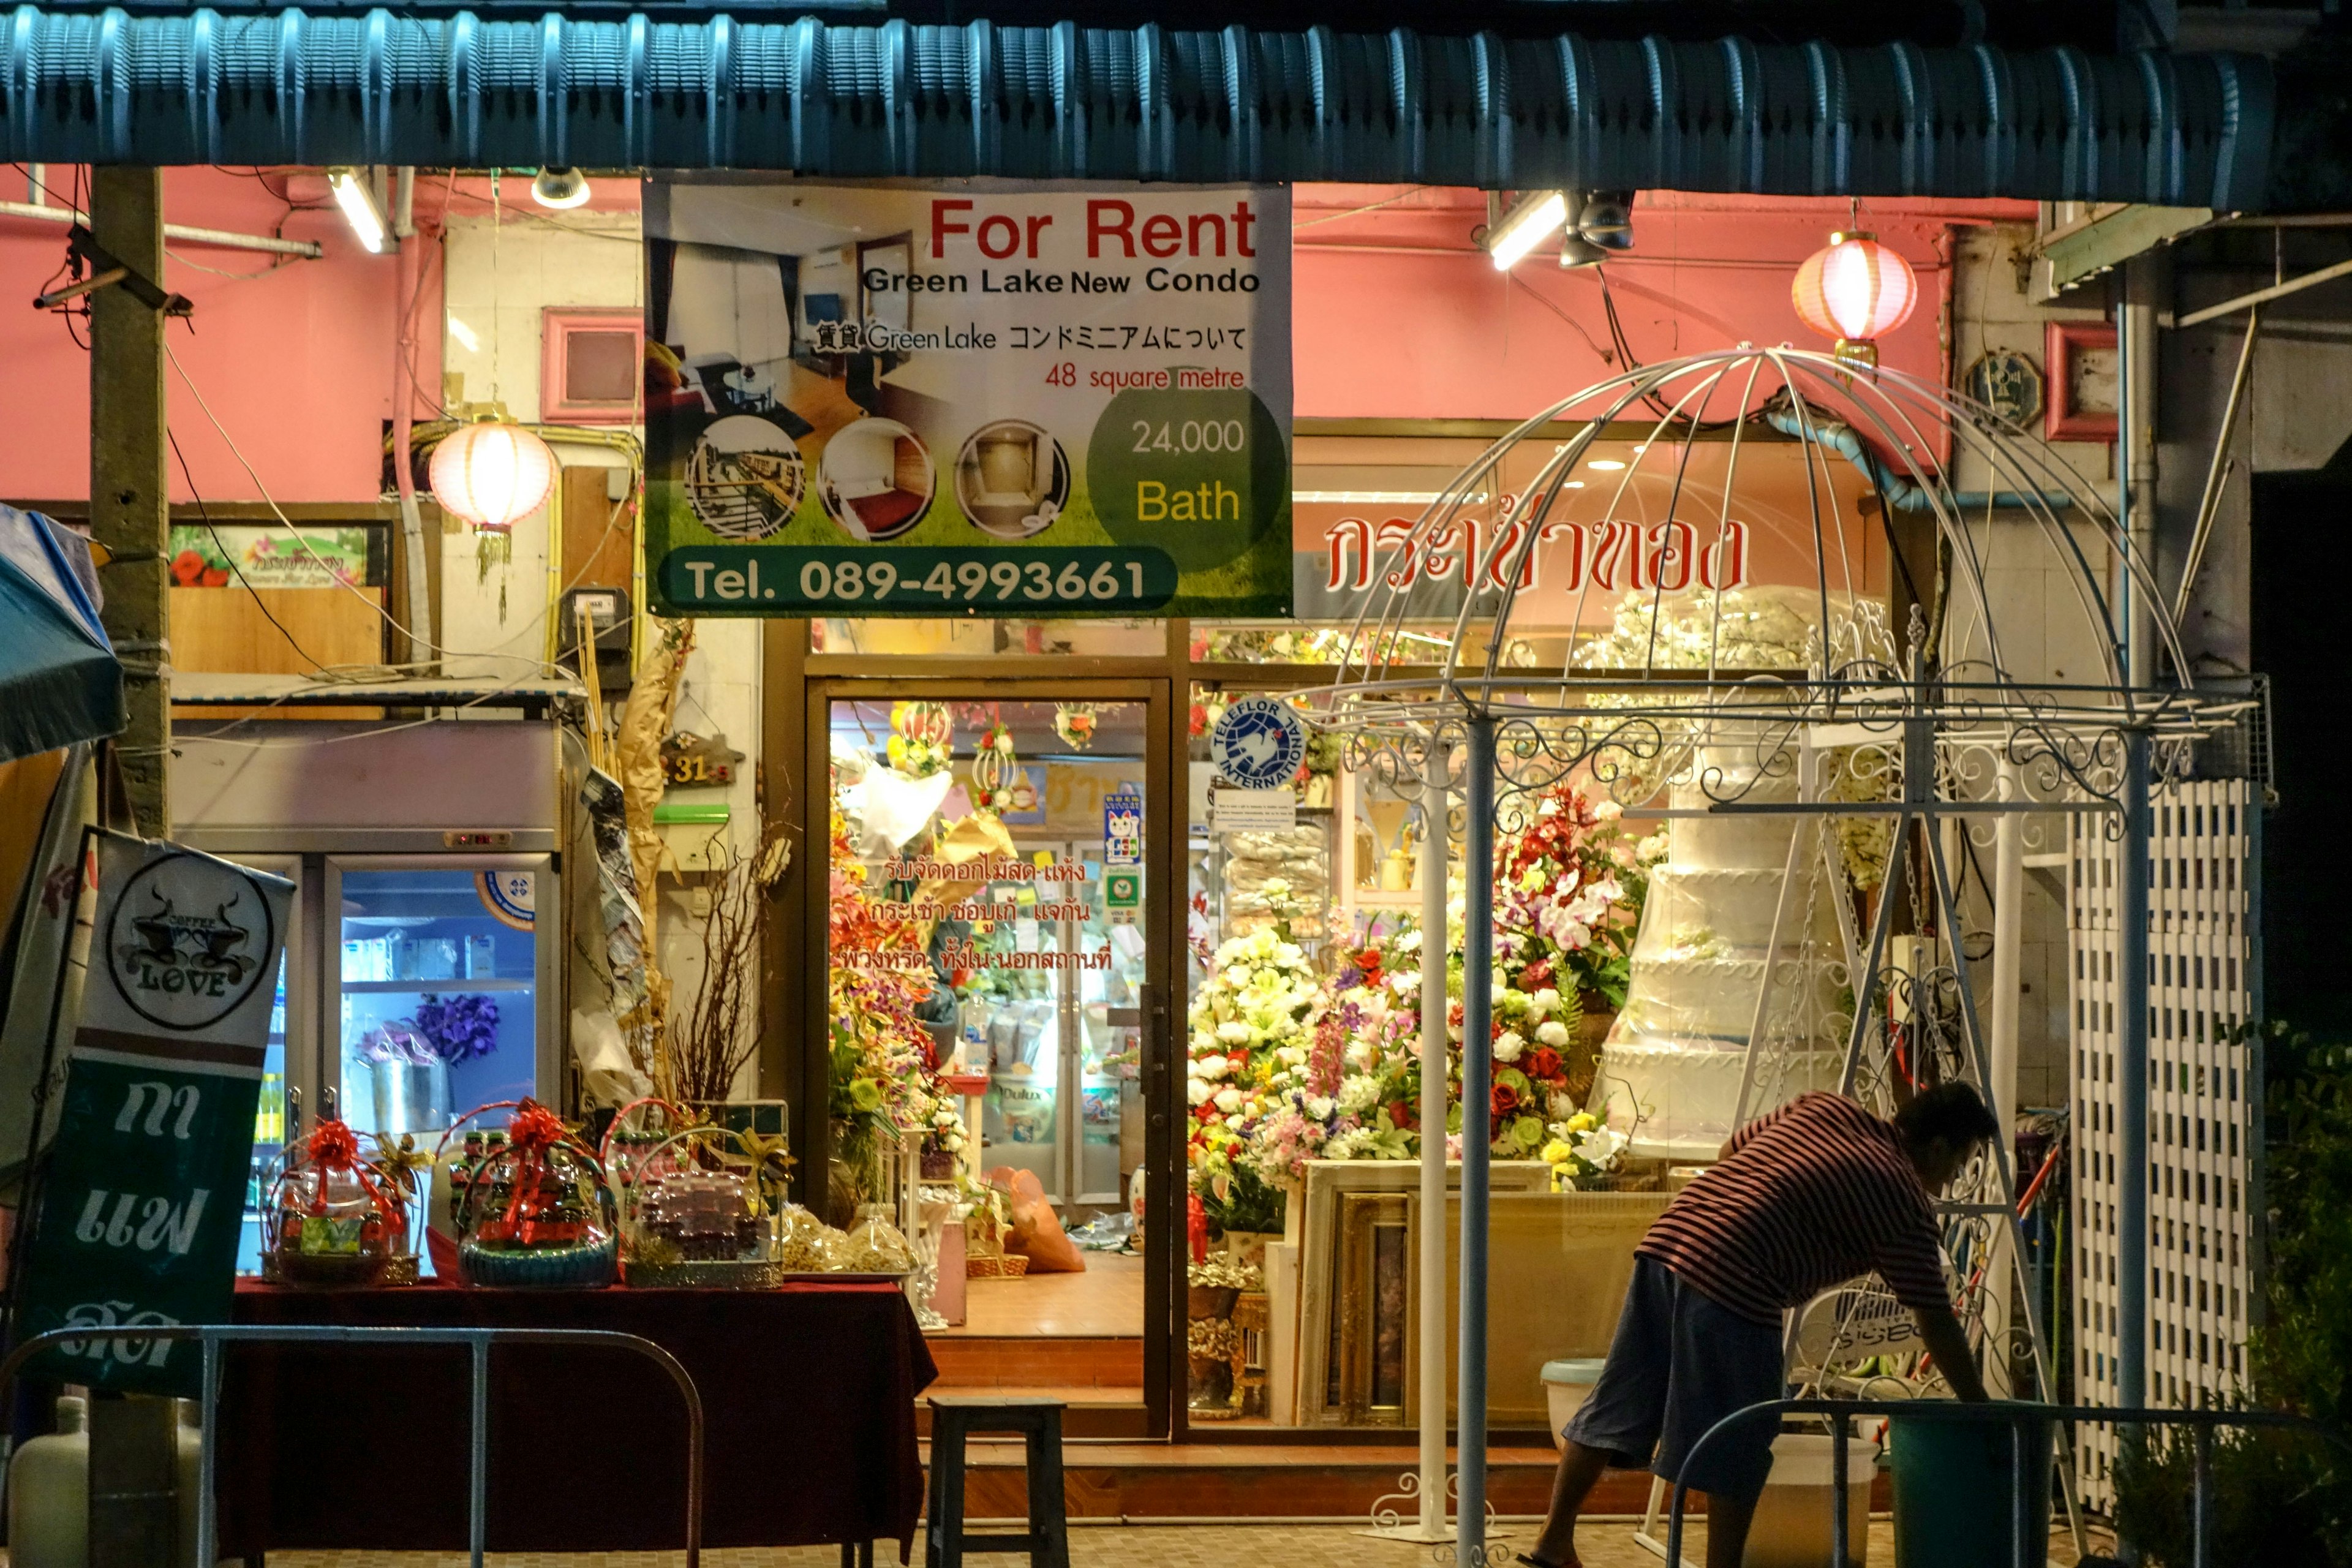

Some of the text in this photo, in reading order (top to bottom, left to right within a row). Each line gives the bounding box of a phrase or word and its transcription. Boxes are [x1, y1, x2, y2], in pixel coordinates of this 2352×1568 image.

[930, 199, 1256, 258] For Rent
[864, 266, 1260, 294] Green Lake New Condo
[869, 325, 939, 349] Green
[946, 322, 996, 349] Lake
[1010, 325, 1245, 350] コンドミニアムについて
[1046, 363, 1244, 394] 48 square metre
[1132, 421, 1243, 454] 24,000
[1137, 481, 1240, 521] Bath
[1325, 492, 1750, 595] กระเช้าทอง
[685, 560, 1144, 600] Tel. 089-4993661
[1214, 701, 1280, 747] TELEFLOR
[1219, 717, 1302, 789] INTERNATIONAL
[871, 895, 1090, 933] กระเช้า ช่อบูเก้ แจกัน
[841, 943, 927, 970] พวงหรีด
[137, 963, 226, 997] LOVE
[115, 1082, 200, 1139] กา
[75, 1188, 211, 1255] แฟ
